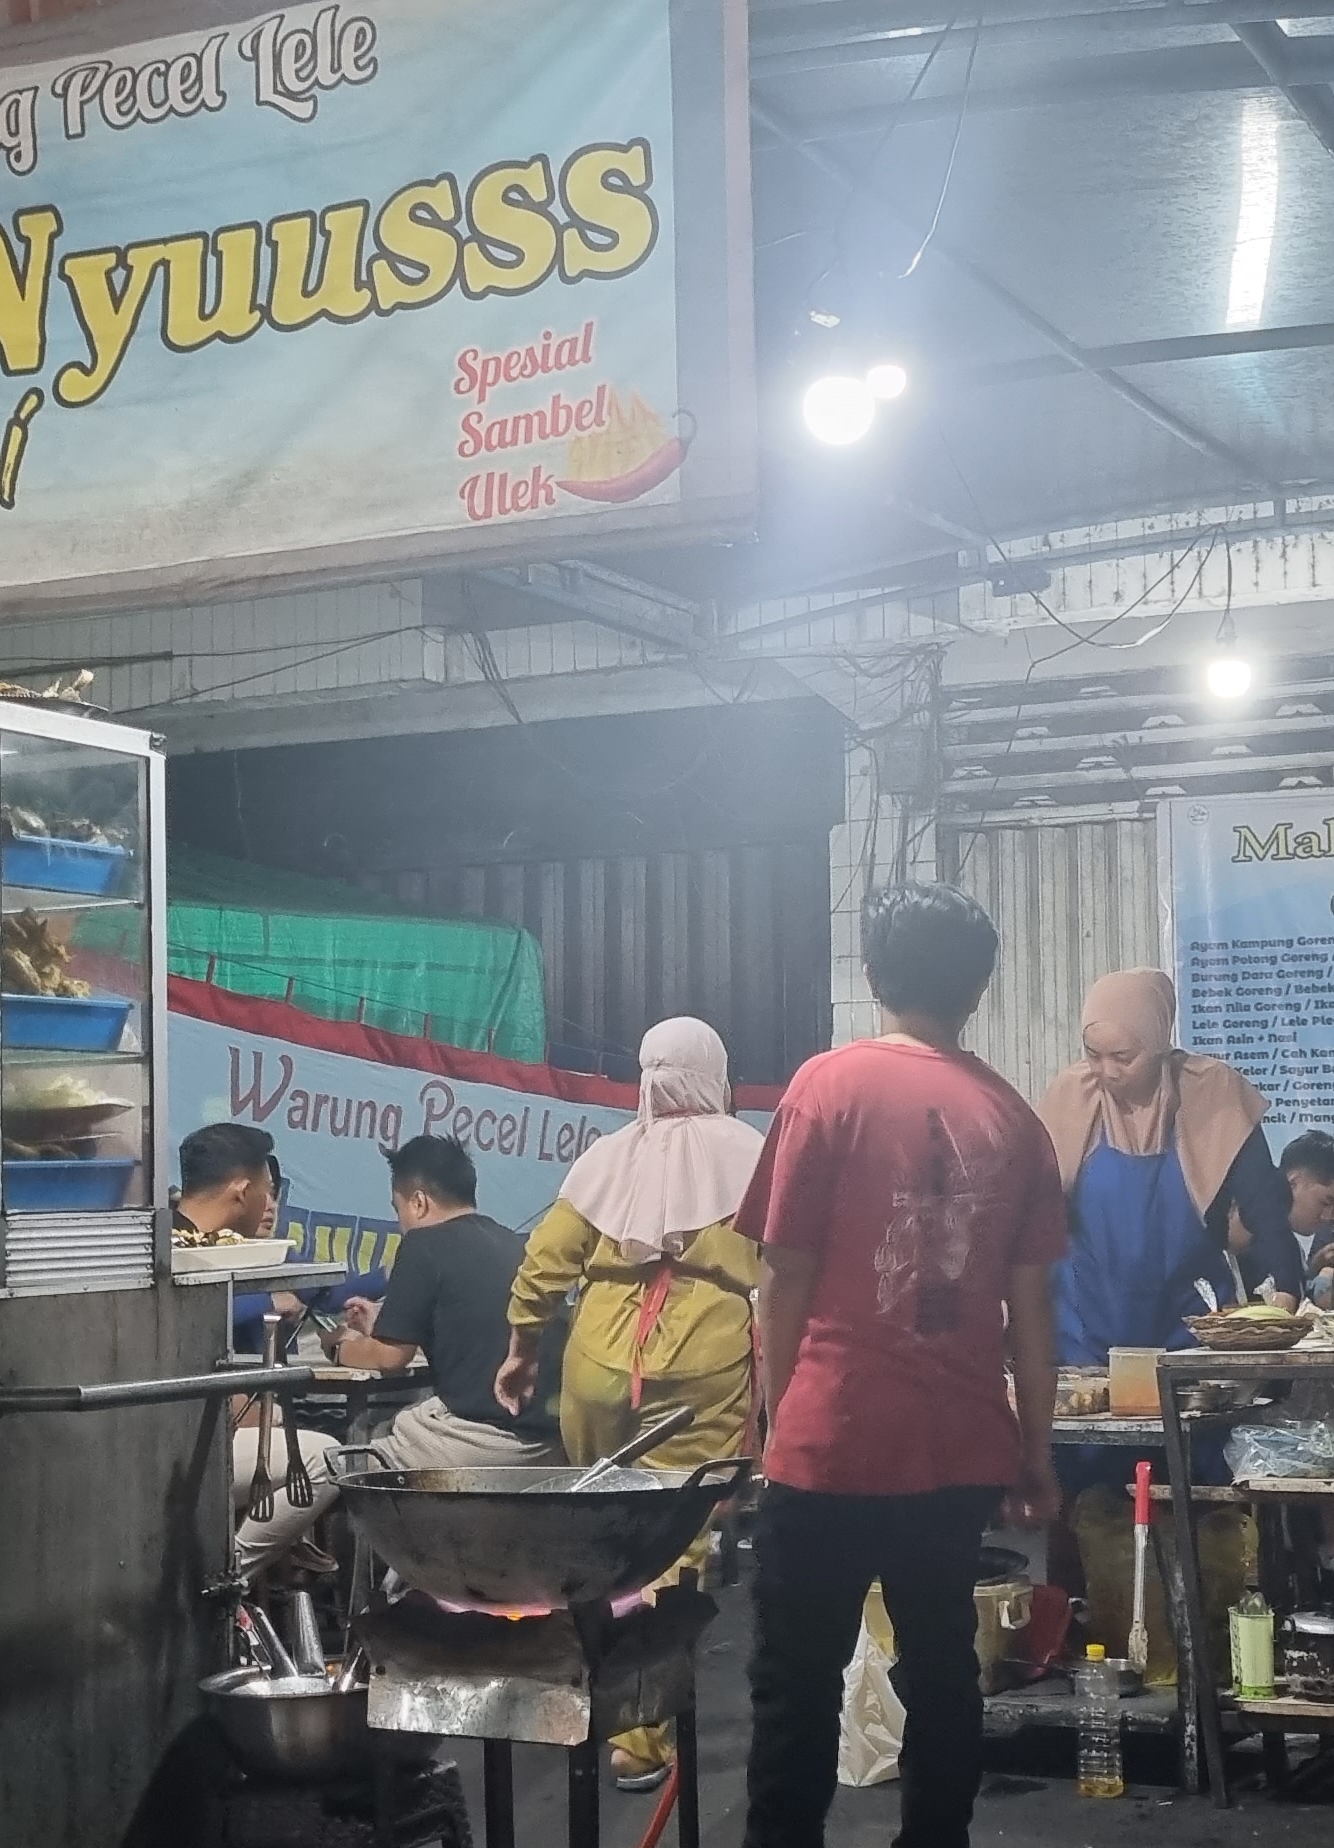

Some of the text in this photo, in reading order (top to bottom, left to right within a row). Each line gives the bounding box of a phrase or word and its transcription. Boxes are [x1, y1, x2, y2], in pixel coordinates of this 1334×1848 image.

[51, 32, 230, 140] Pecel
[239, 4, 378, 123] Lele
[453, 320, 595, 405] Spesial
[457, 383, 608, 459] Sambel
[458, 464, 557, 521] Ulek
[1190, 941, 1229, 952] Ayam
[1231, 939, 1294, 950] Kampung
[1190, 957, 1229, 968] Ayam
[1232, 955, 1278, 965] Potong
[1281, 953, 1328, 963] Goreng
[1191, 973, 1238, 983] Burung
[1242, 970, 1273, 980] Dara
[1276, 969, 1323, 979] Goreng
[1192, 987, 1233, 998] Bebek
[1236, 986, 1283, 997] Goreng
[1294, 982, 1334, 993] Bebek
[1191, 1004, 1223, 1014] Ikan
[1254, 1002, 1302, 1013] Goreng
[1192, 1019, 1220, 1030] Lele
[1222, 1019, 1269, 1029] Goreng
[1281, 1016, 1309, 1026] Lele
[1192, 1035, 1223, 1046] Ikan
[1226, 1033, 1255, 1045] Asin
[1233, 1049, 1269, 1060] Asem
[1281, 1048, 1307, 1059] Cah
[1280, 1065, 1320, 1077] Sayur
[227, 1044, 403, 1152] Warung
[419, 1079, 529, 1158] Pecel
